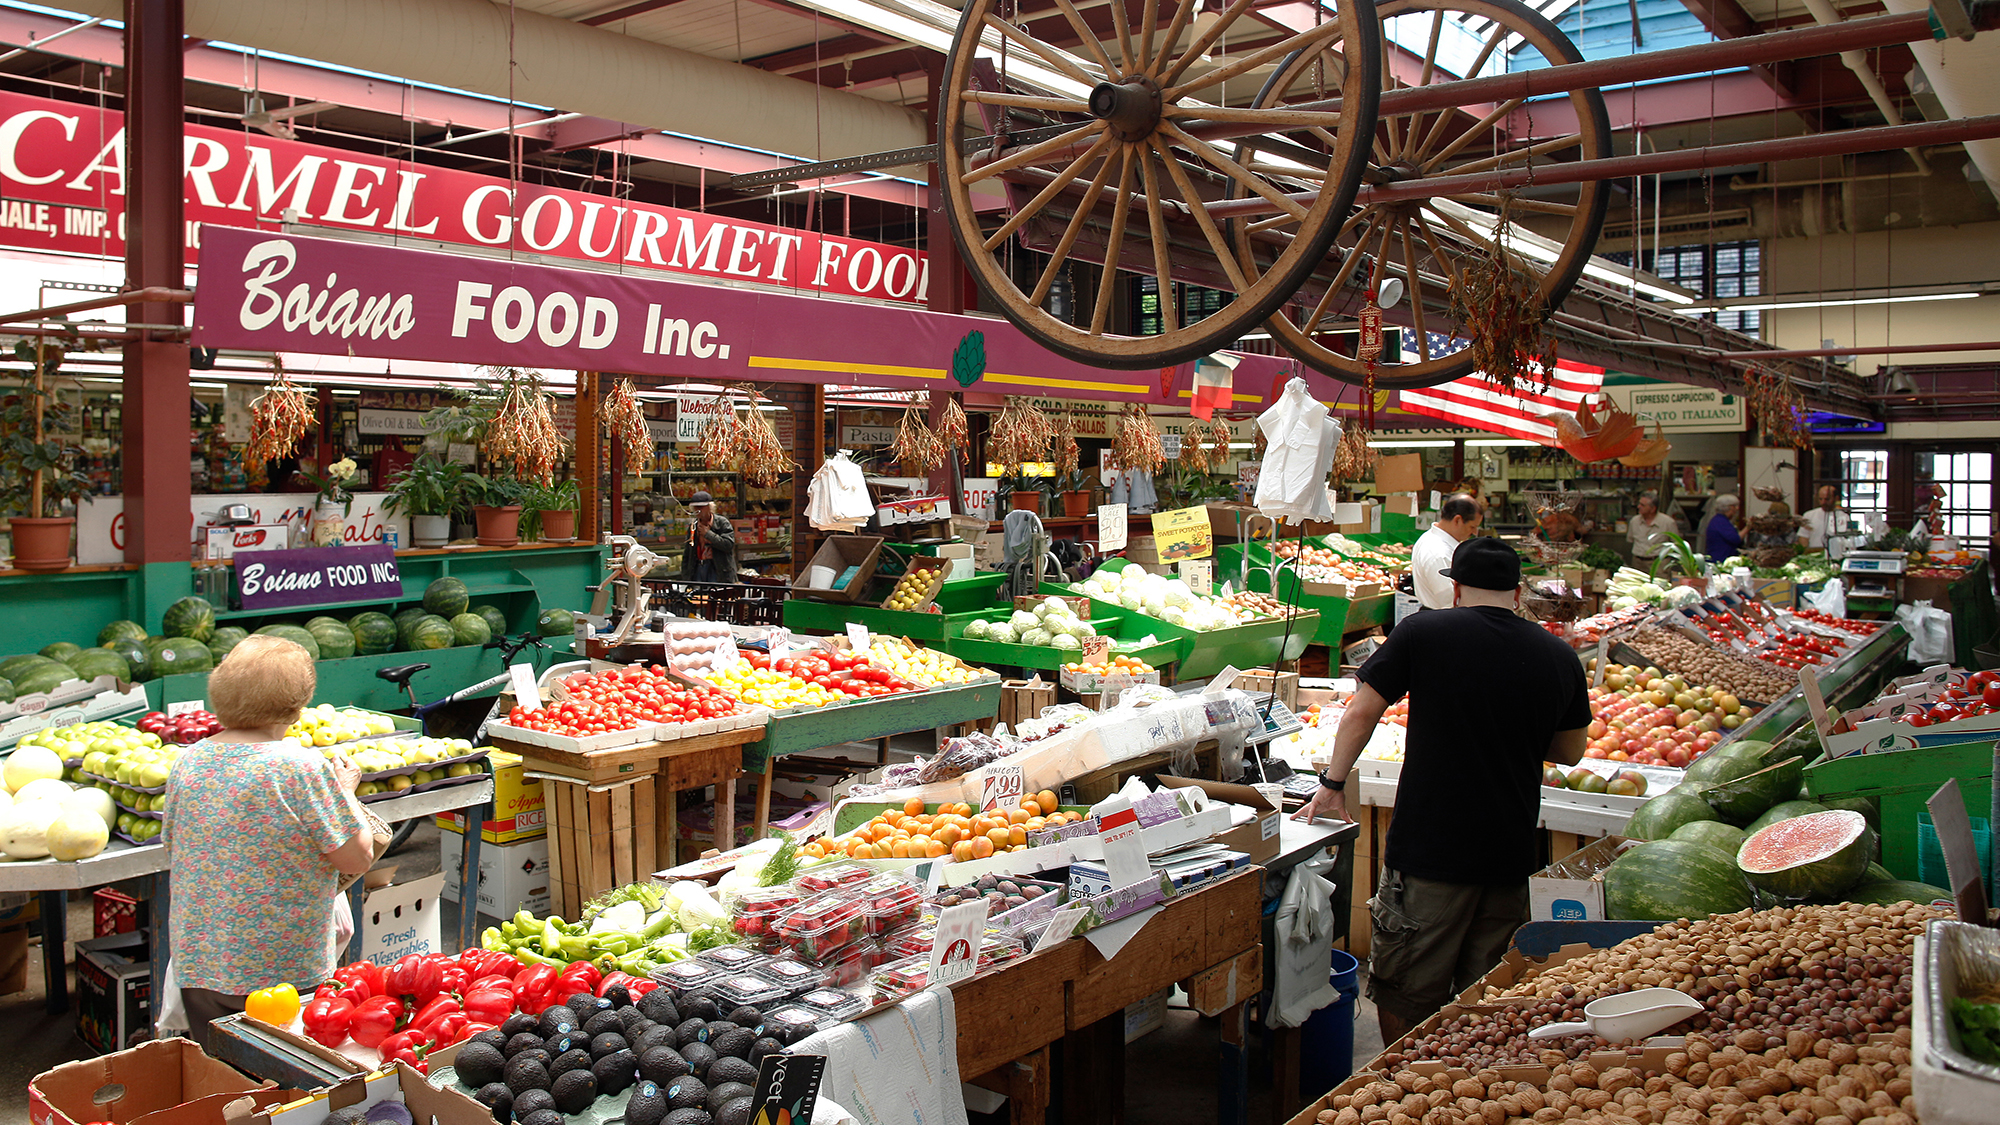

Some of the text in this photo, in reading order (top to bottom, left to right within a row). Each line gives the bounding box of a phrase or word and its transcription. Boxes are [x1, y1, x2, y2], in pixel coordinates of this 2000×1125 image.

[64, 208, 111, 239] IMP.
[461, 184, 802, 281] GOURMET
[811, 239, 928, 301] FOO
[239, 239, 731, 360] Boiano FOOD Inc.
[680, 399, 720, 414] Welcom
[1636, 392, 1715, 404] ESPRESSO CAPPUCCINO
[362, 415, 382, 428] Olive
[384, 416, 396, 428] Oil
[397, 418, 404, 429] &
[1682, 409, 1736, 420] ITALIANO
[648, 426, 677, 438] mporte
[679, 418, 695, 437] CAFE
[850, 428, 892, 442] Pasta
[1158, 523, 1210, 538] SWEET POTATOES
[242, 562, 400, 595] Boiano FOOD INC.
[985, 766, 1020, 775] APRICOTS
[517, 811, 545, 828] RICE
[1556, 908, 1583, 919] AEP
[381, 926, 416, 947] Fresh
[367, 939, 429, 966] Vegetables
[931, 958, 974, 981] ALTAR
[850, 1090, 871, 1123] football
